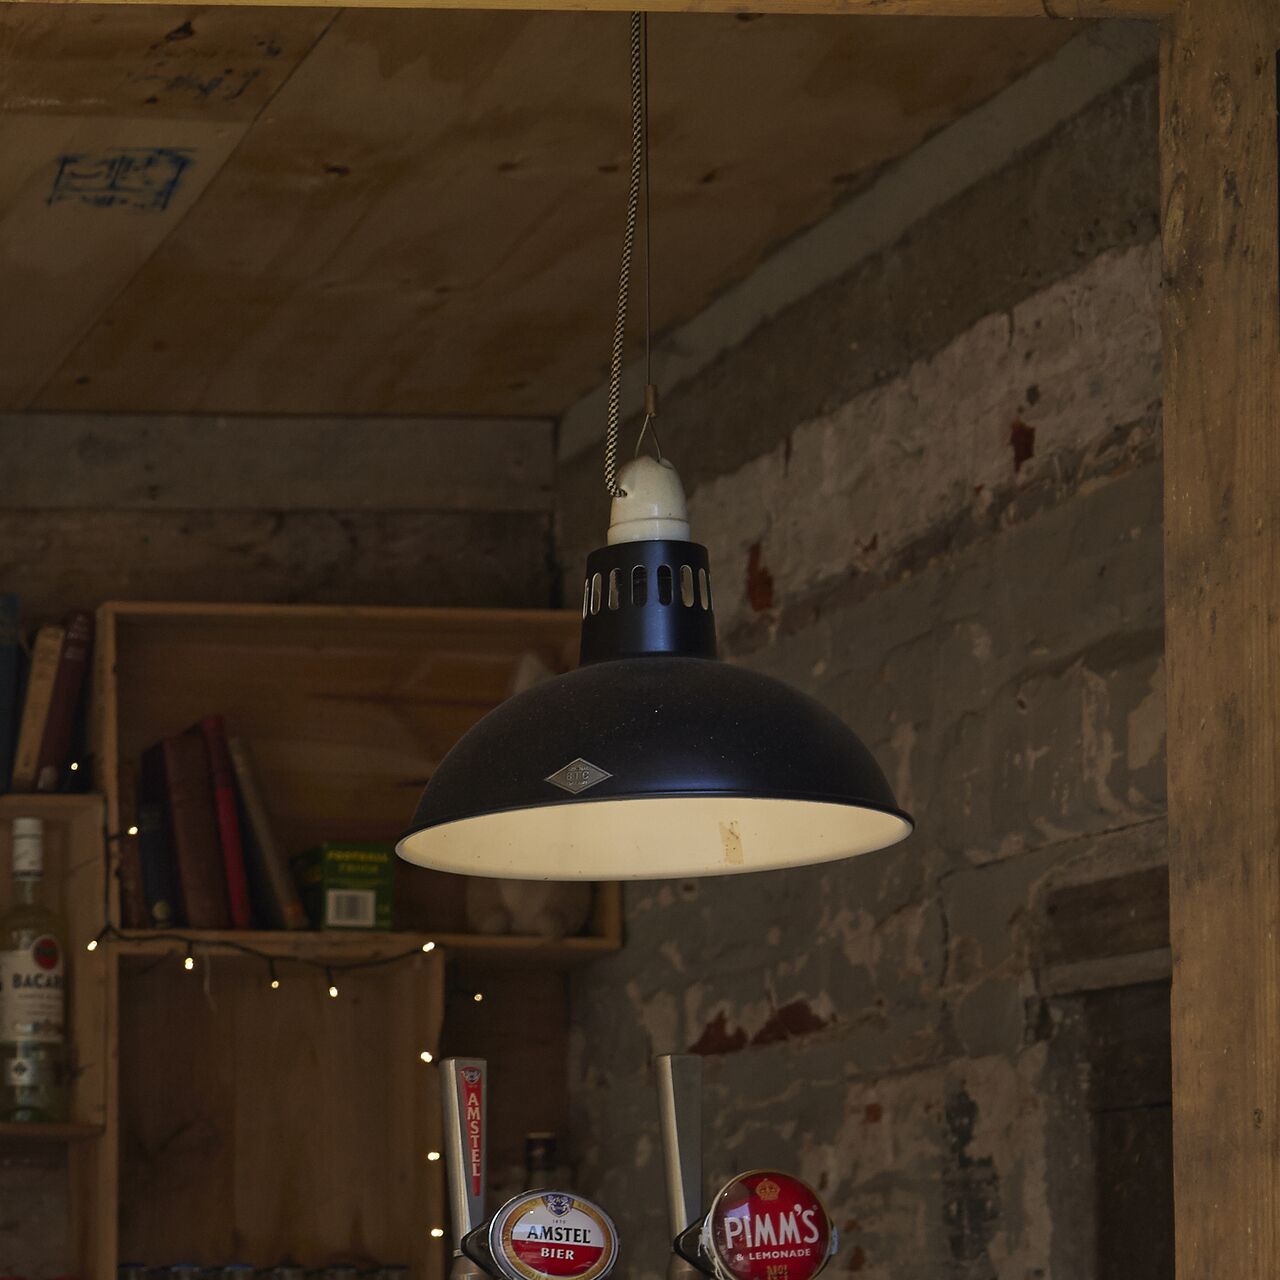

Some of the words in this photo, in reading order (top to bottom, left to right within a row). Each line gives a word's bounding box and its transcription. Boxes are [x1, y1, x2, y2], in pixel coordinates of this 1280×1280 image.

[467, 1092, 481, 1177] AMSTEL
[527, 1225, 591, 1244] AMSTEL
[724, 1203, 820, 1250] PIMM'S
[541, 1247, 575, 1260] BIER
[749, 1248, 811, 1260] LEMONADE
